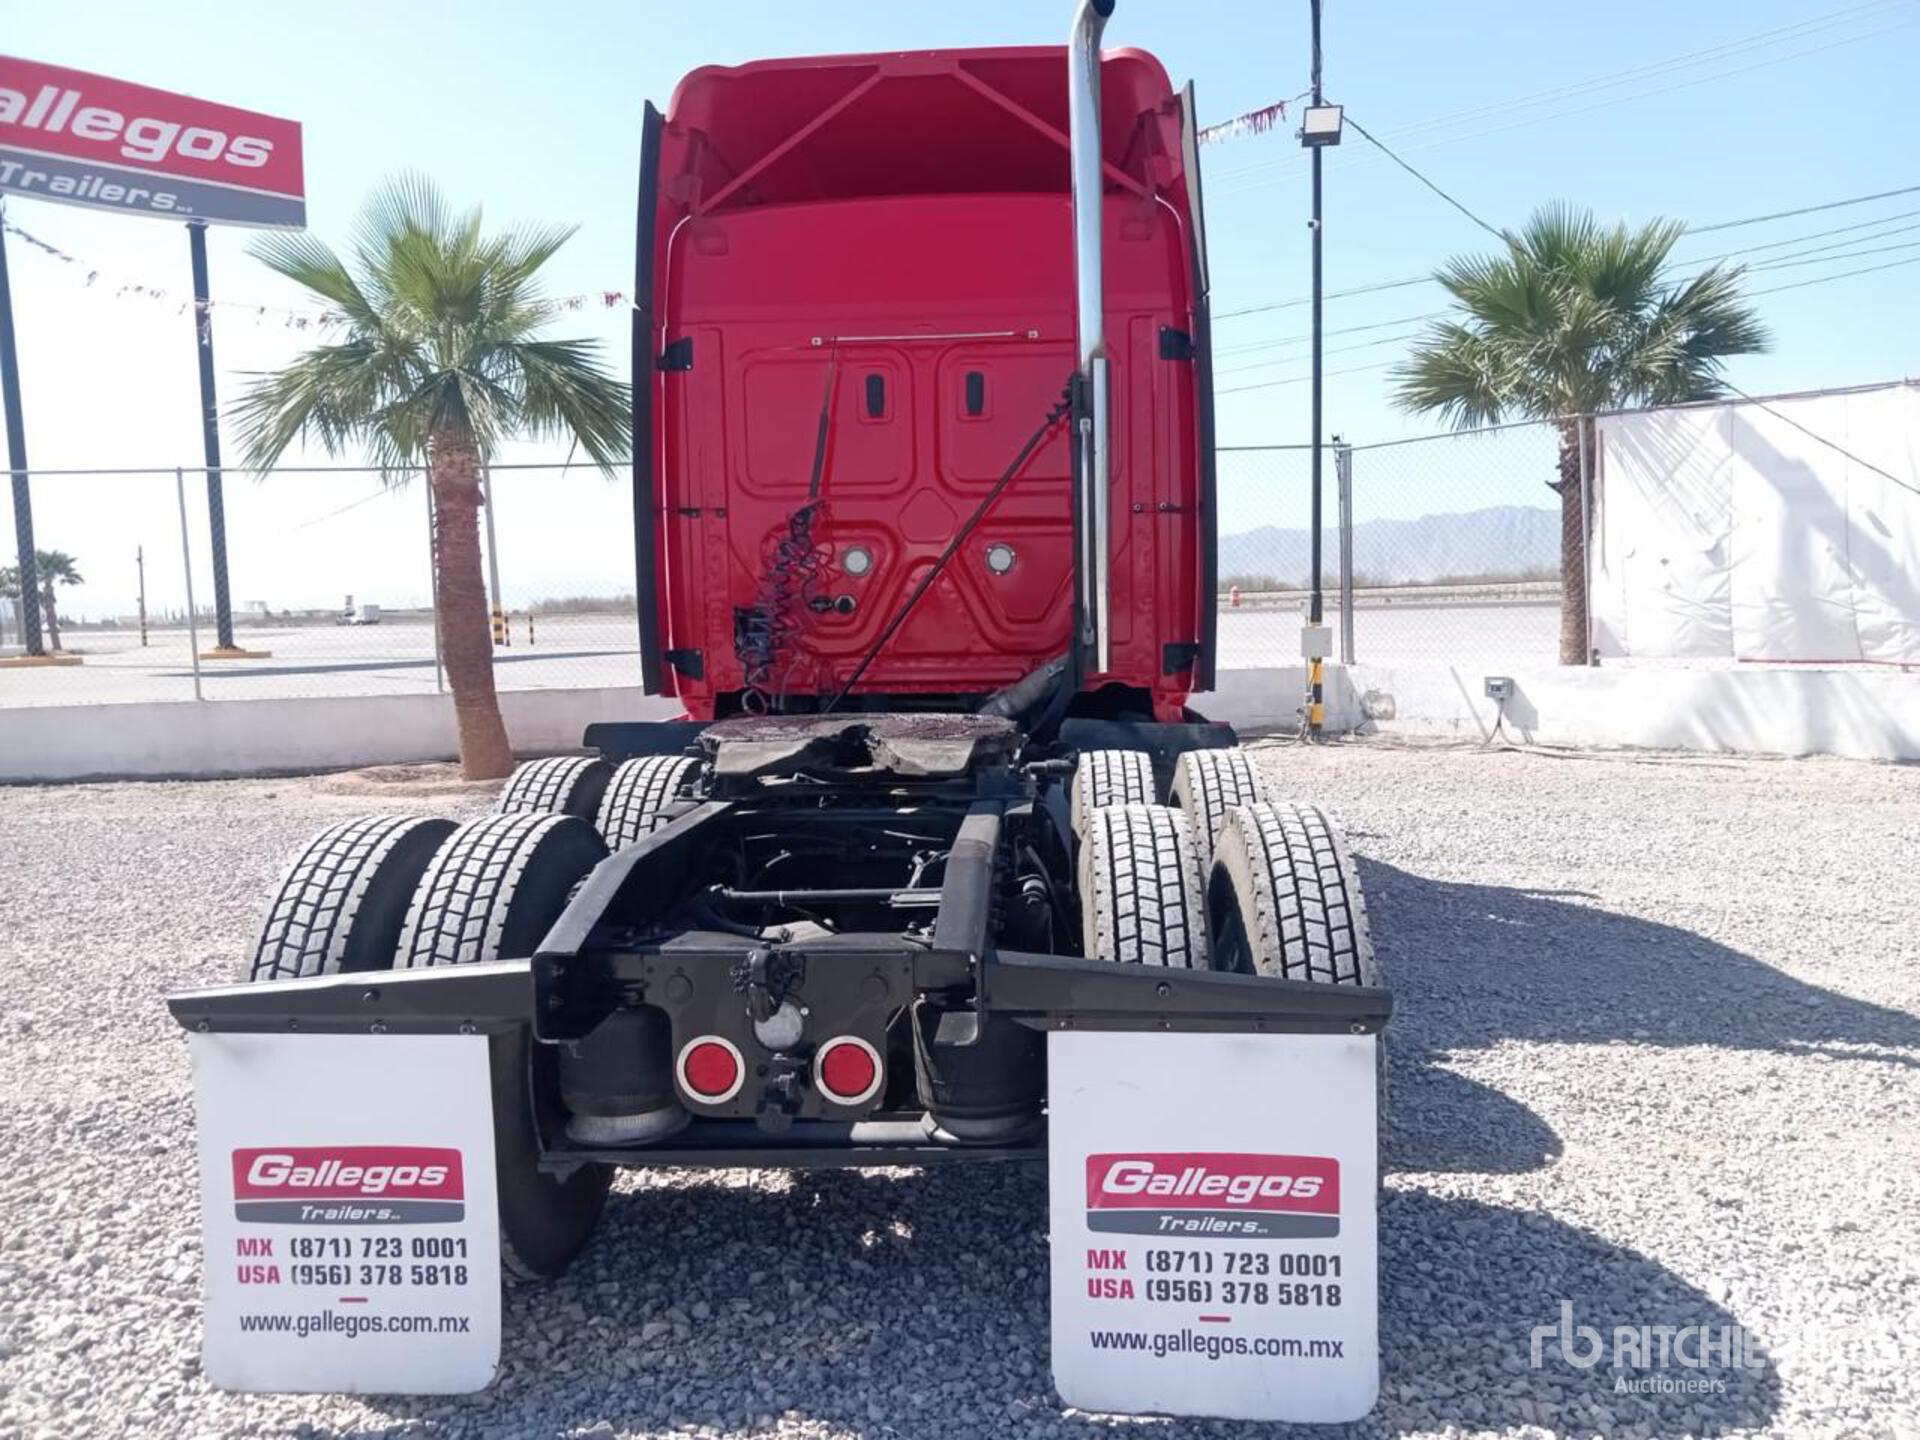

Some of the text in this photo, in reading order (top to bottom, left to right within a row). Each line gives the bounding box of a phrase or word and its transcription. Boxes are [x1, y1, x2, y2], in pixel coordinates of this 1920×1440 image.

[0, 160, 178, 211] Trailers
[247, 1154, 448, 1194] Gallegos
[1101, 1160, 1324, 1204] Gallegos
[301, 1205, 392, 1221] Trailers
[1158, 1215, 1259, 1234] Trailers
[237, 1237, 468, 1259] MX (871) 723 0001
[237, 1264, 468, 1286] USA (956) 378 5818
[1087, 1249, 1342, 1277] MX (871) 723 0001
[1087, 1278, 1342, 1307] USA (956) 378 5818
[240, 1310, 470, 1338] www.gallegos.com.mx
[1090, 1328, 1344, 1360] www.gallegos.com.mx
